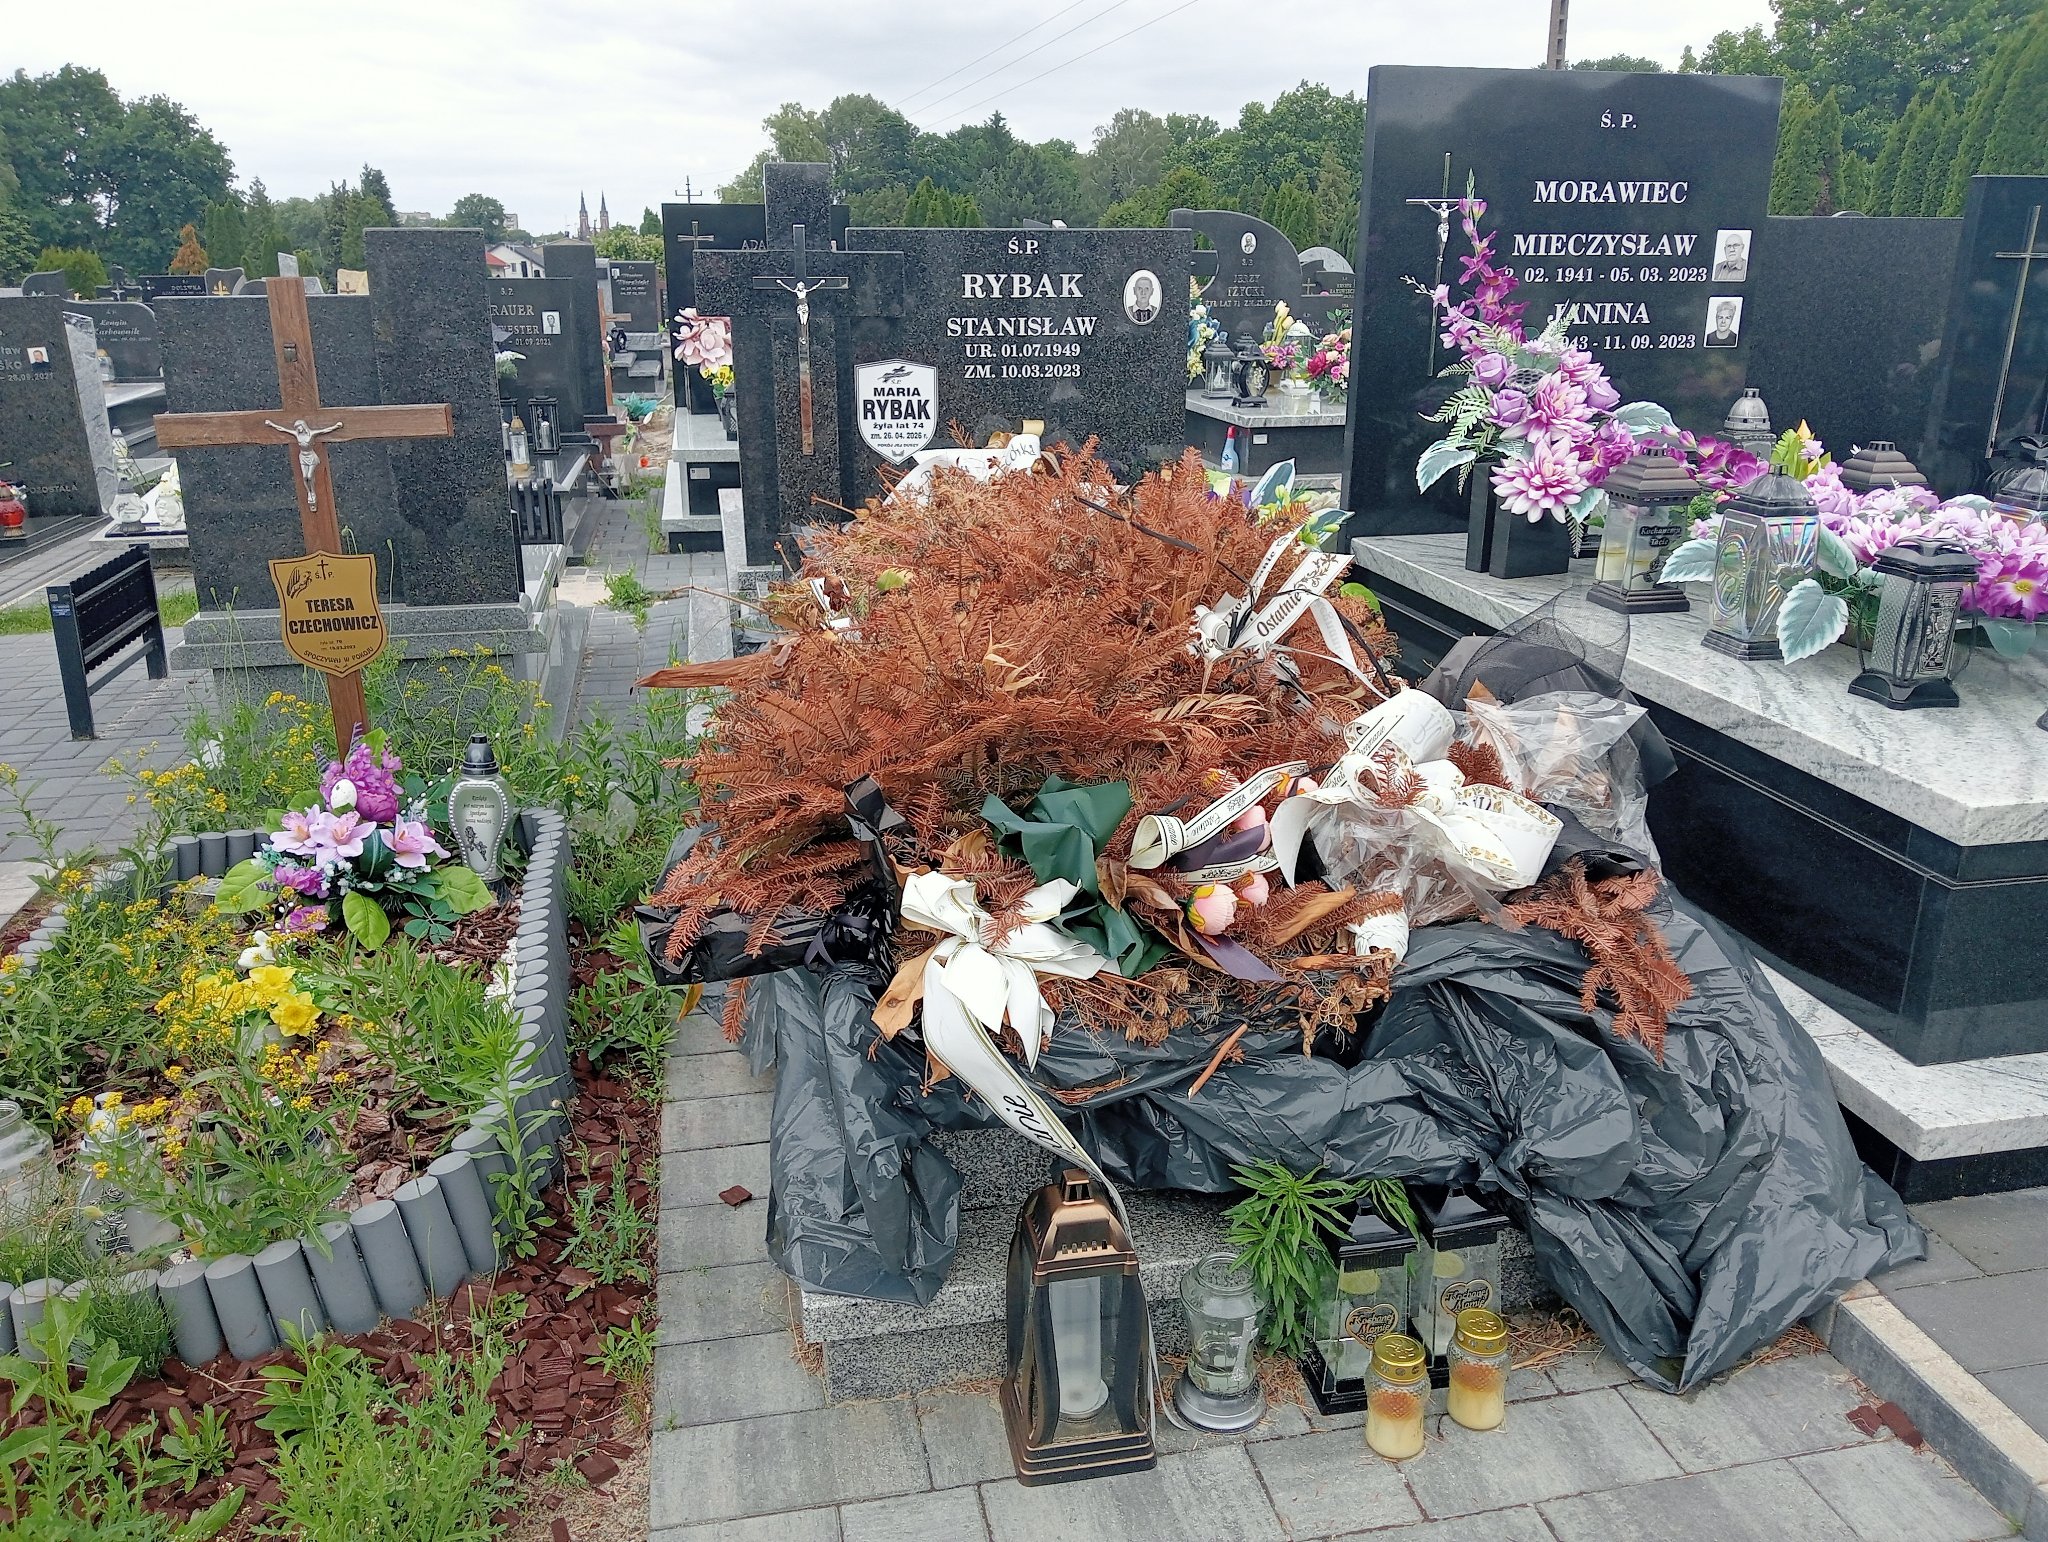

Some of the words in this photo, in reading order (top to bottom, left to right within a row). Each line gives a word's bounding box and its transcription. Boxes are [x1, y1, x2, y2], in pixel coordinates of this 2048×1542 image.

[1601, 109, 1615, 128] Ś.
[1620, 113, 1637, 128] P.
[1533, 180, 1688, 203] MORAWIEC
[1008, 237, 1039, 255] Ś.P.
[1511, 234, 1698, 256] MIECZYSŁAW
[1524, 267, 1549, 282] 02.
[1555, 267, 1594, 282] 1941
[1610, 267, 1634, 282] 05.
[1639, 267, 1664, 282] 03.
[1668, 267, 1708, 282] 2023
[961, 273, 1084, 298] RYBAK
[946, 317, 1097, 337] STANISŁAW
[965, 343, 997, 358] UR.
[1001, 343, 1081, 357] 01.07.1949
[1604, 335, 1625, 350] 11.
[1630, 335, 1654, 349] 09.
[1659, 334, 1696, 349] 2023
[964, 364, 996, 378] ZM.
[1001, 364, 1081, 378] 10.03.2023
[873, 388, 921, 396] MARIA
[863, 400, 931, 420] RYBAK
[305, 598, 355, 613] TERESA
[1257, 590, 1303, 638] Ostatnie
[288, 616, 379, 634] CZECHOWICZ
